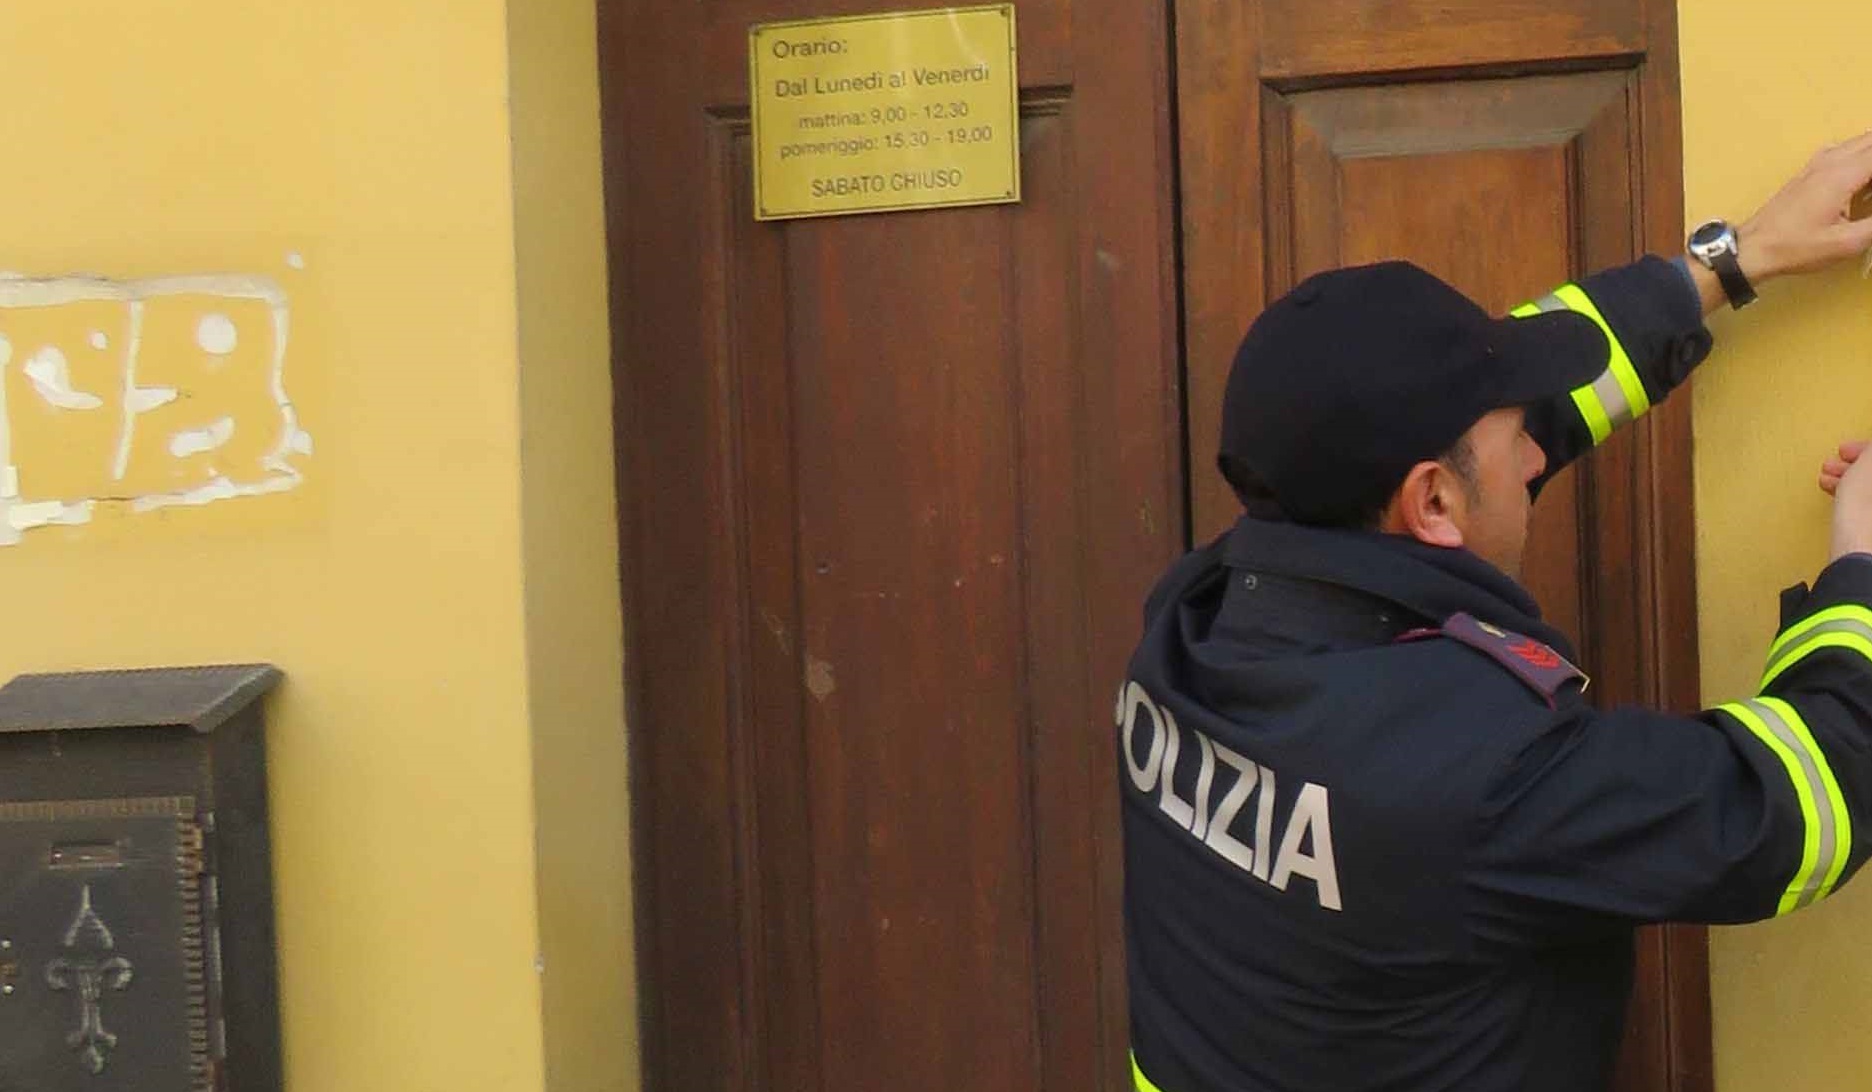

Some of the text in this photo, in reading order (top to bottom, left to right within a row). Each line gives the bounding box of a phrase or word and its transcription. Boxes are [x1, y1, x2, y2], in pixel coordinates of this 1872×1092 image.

[773, 39, 847, 58] Orario:
[776, 79, 807, 97] Dal
[812, 169, 962, 197] SABATO CHIUSO
[1116, 680, 1342, 912] OLIZIA
